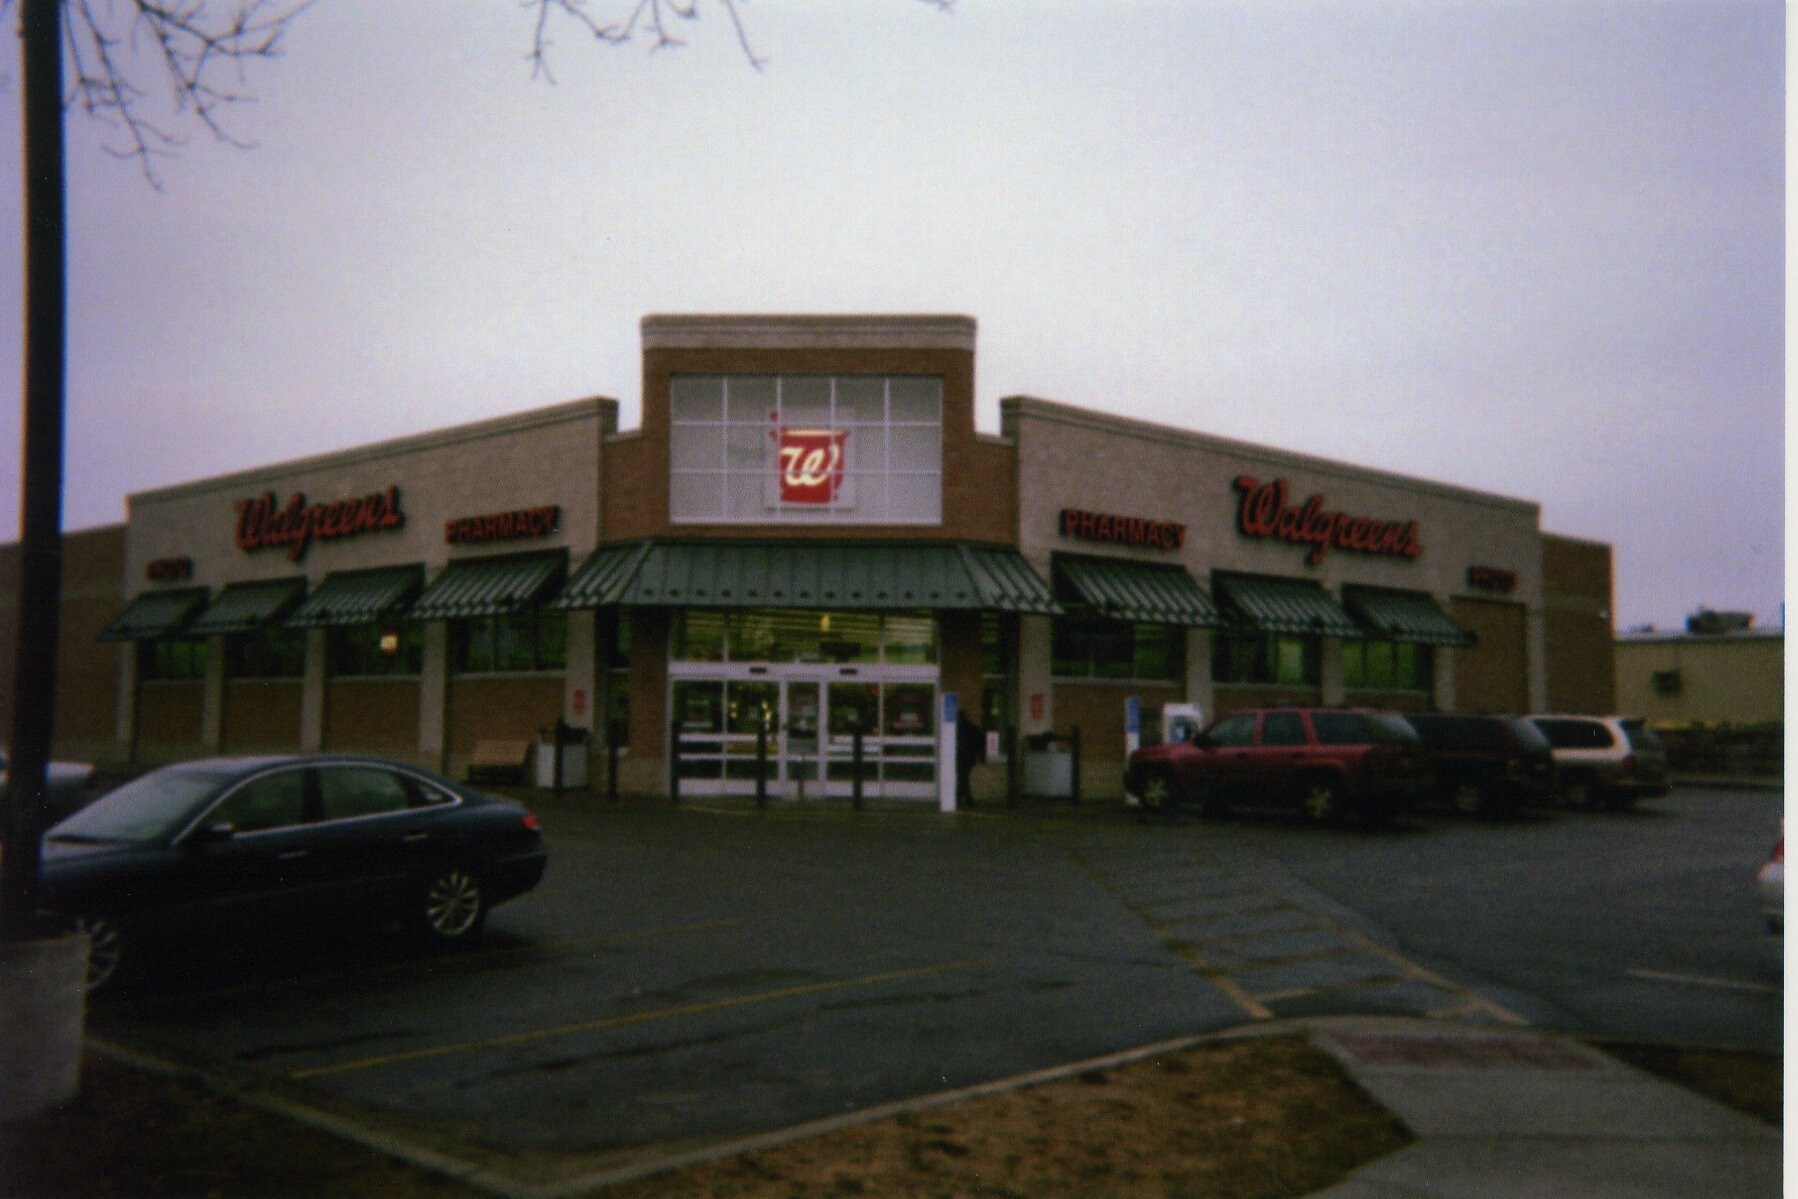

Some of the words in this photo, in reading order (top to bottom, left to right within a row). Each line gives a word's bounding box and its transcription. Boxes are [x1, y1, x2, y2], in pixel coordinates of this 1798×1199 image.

[234, 485, 404, 562] Walgreens
[444, 505, 560, 543] PHARMACY
[1060, 508, 1186, 549] PHARMACY
[1235, 476, 1424, 566] Walgreens
